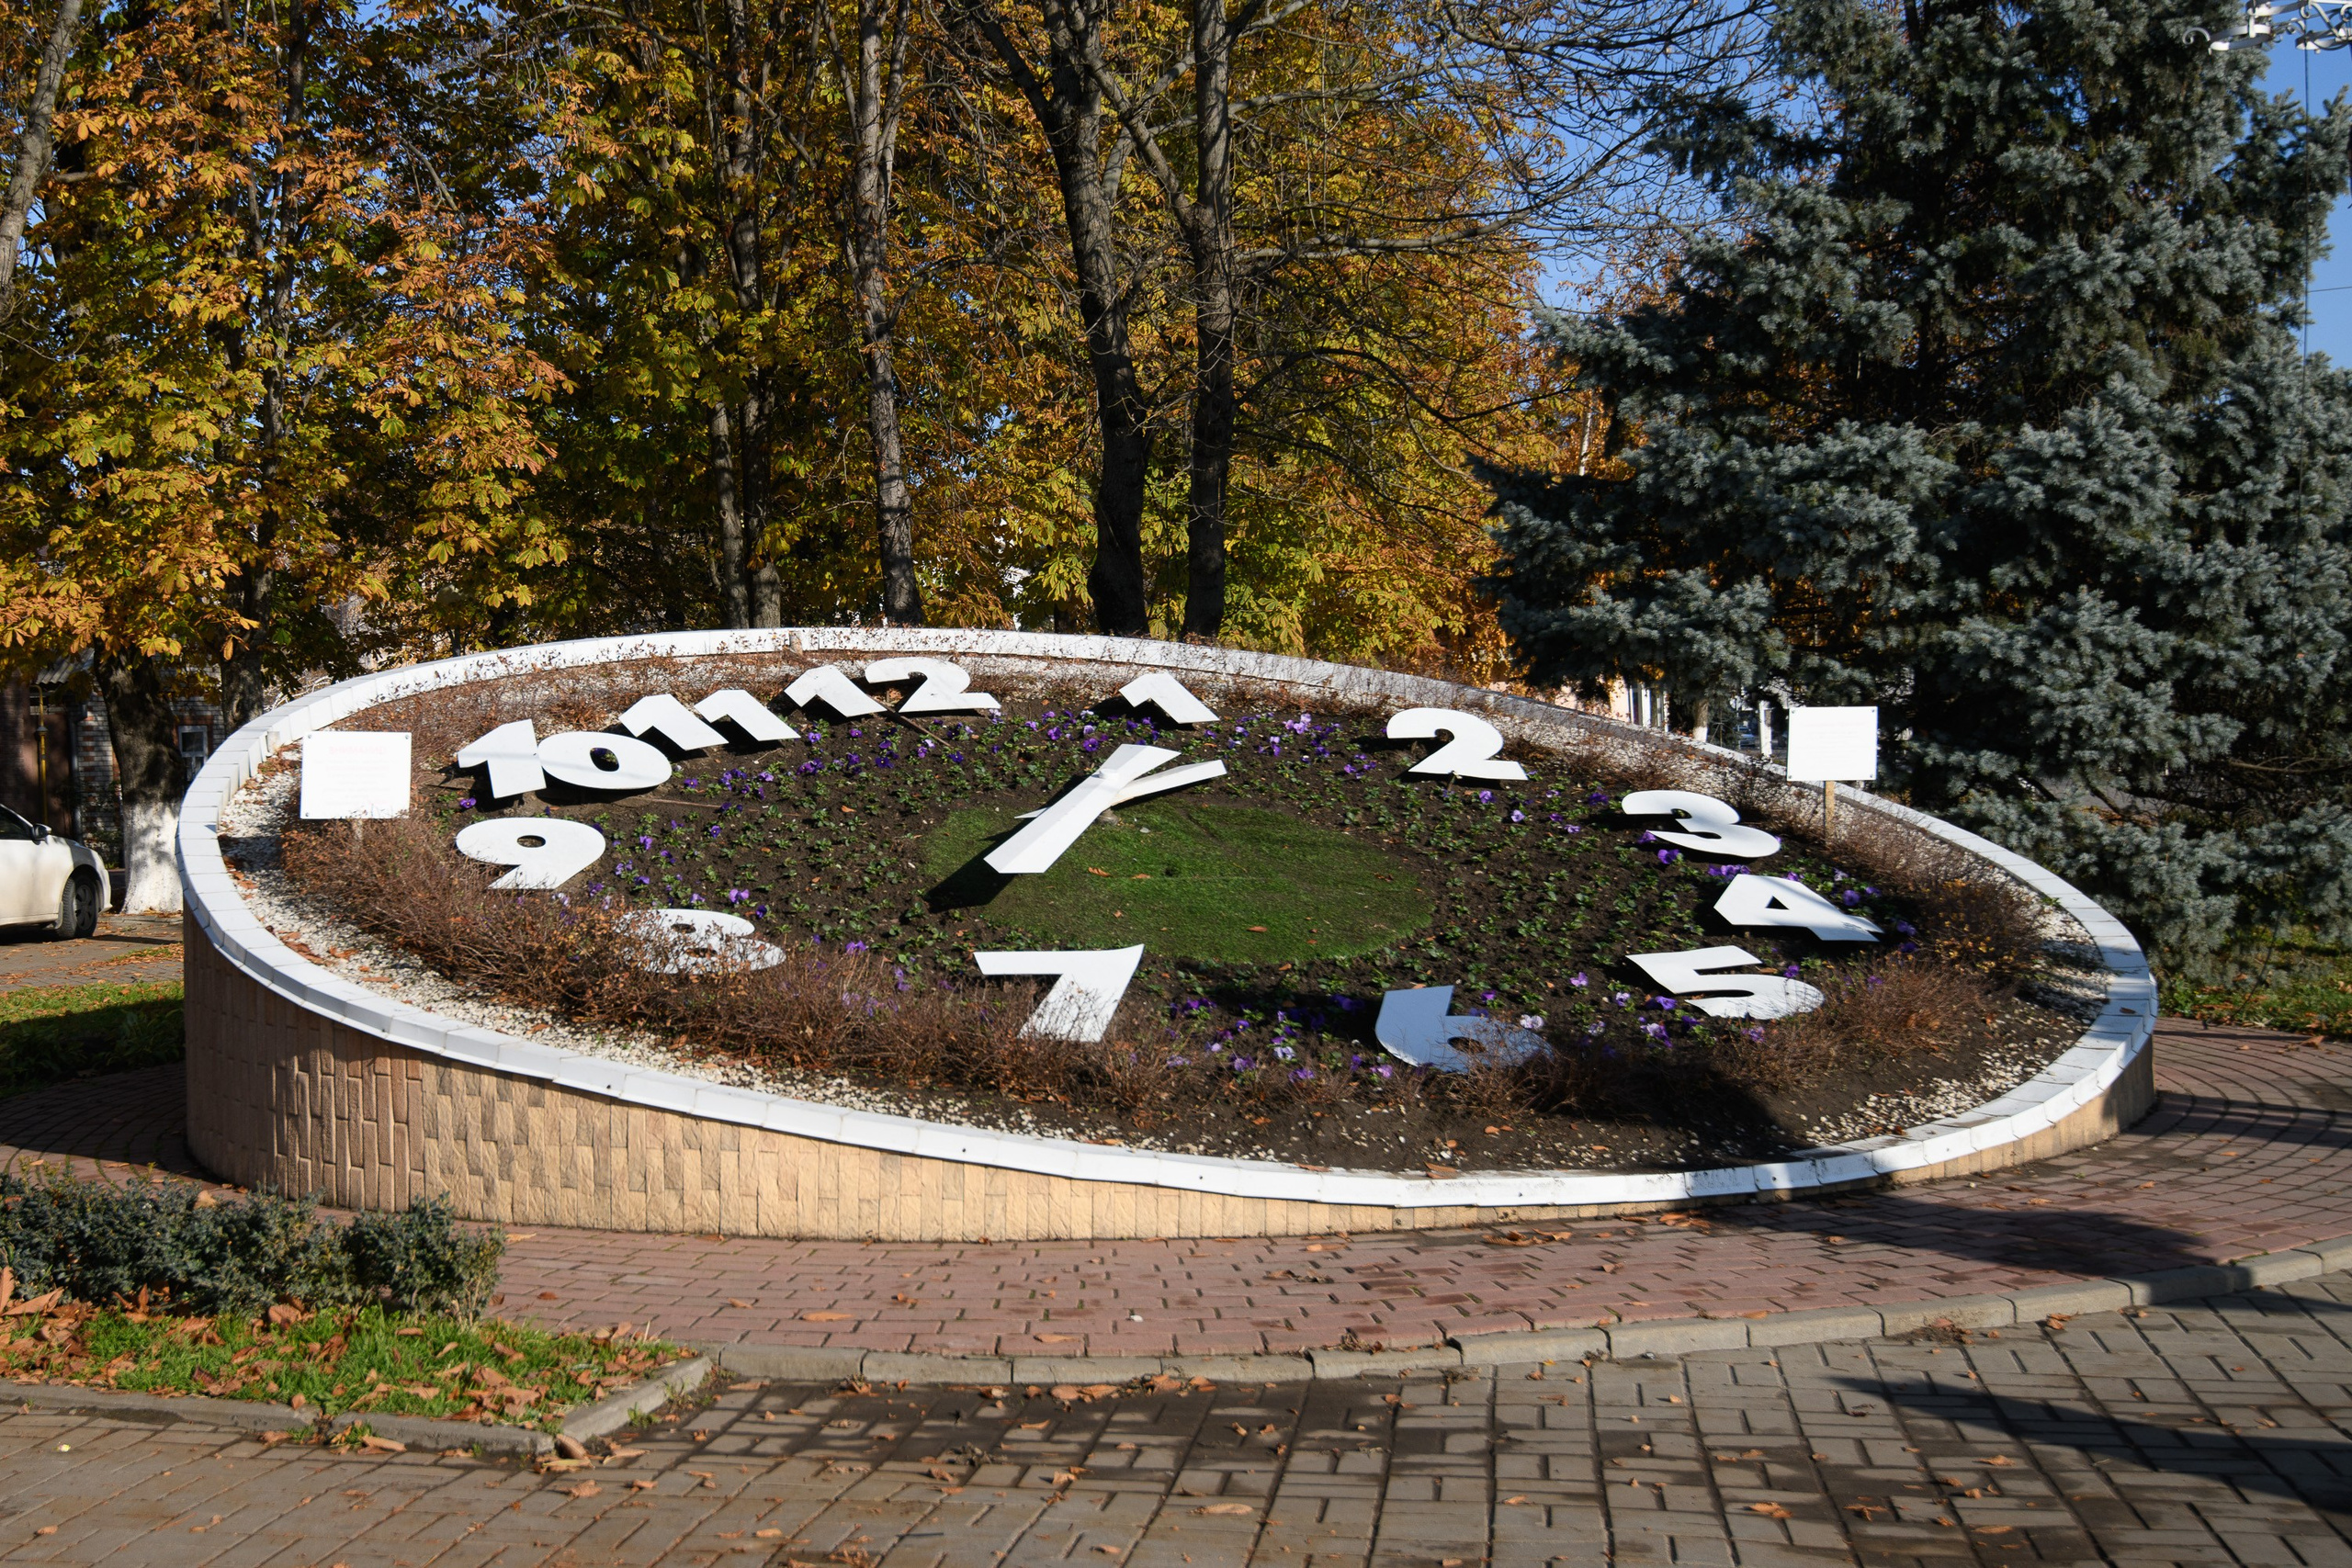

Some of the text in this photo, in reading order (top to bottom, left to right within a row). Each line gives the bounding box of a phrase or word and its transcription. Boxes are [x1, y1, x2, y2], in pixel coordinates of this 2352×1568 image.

[618, 689, 801, 751] 11
[784, 656, 1001, 717] 12
[1119, 672, 1219, 724] 1
[457, 718, 673, 799] 10
[1385, 707, 1529, 781] 2
[455, 817, 606, 890] 9
[1622, 789, 1781, 859] 3
[616, 908, 787, 975] 8
[1713, 874, 1884, 942] 4
[973, 944, 1145, 1043] 7
[1625, 944, 1825, 1021] 5
[1375, 985, 1554, 1074] 6
